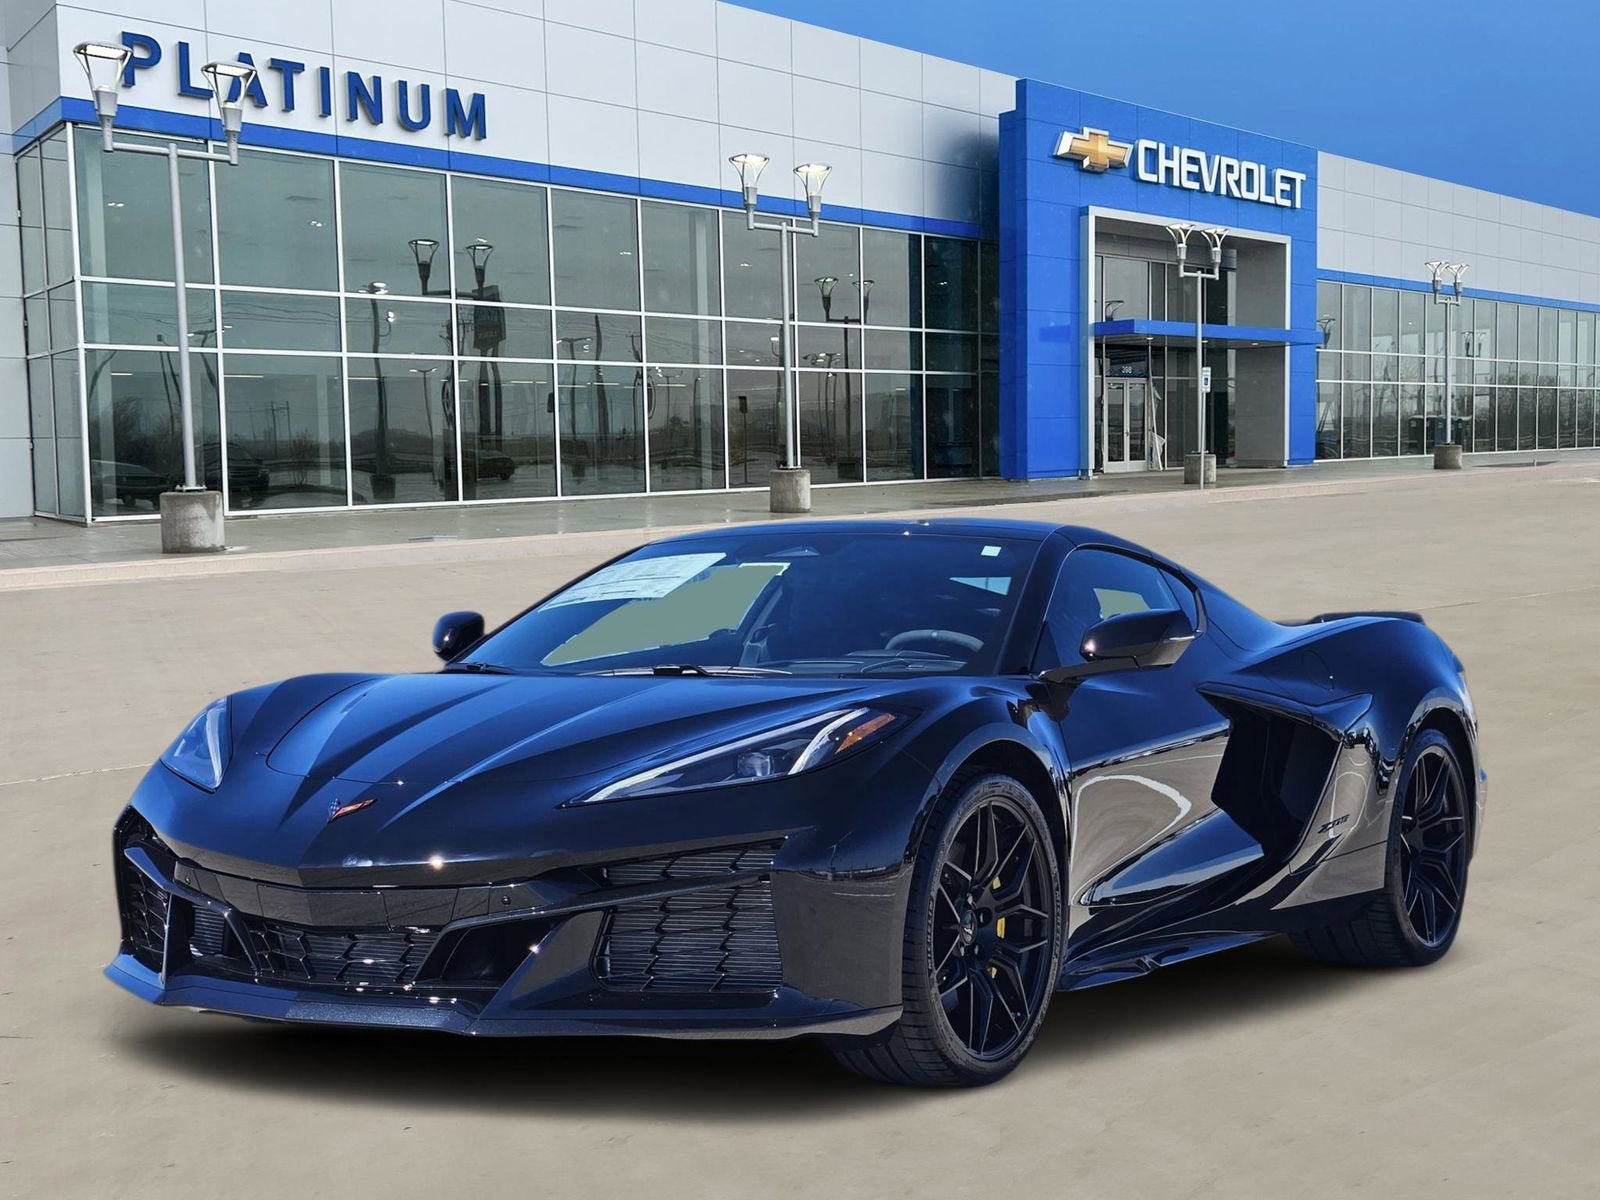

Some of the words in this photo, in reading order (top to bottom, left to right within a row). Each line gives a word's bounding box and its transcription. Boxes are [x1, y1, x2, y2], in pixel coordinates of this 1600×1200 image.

[120, 31, 487, 141] PLATINUM
[1135, 139, 1306, 209] CHEVROLET
[926, 899, 934, 971] MICHELIN
